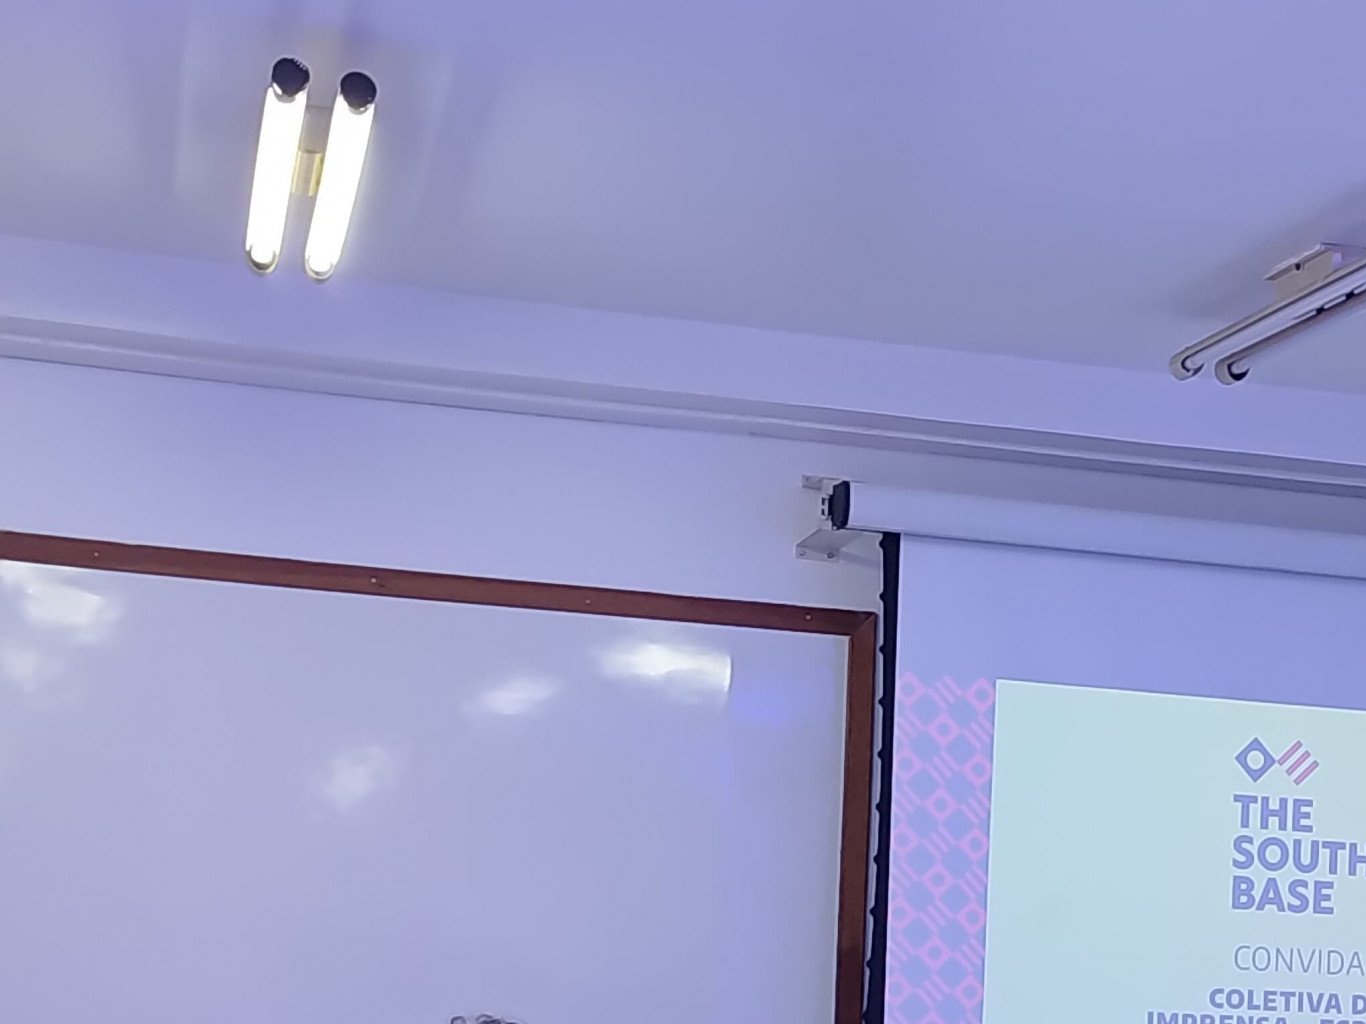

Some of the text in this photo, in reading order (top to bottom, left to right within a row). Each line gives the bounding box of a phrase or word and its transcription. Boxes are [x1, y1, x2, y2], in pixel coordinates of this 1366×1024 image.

[1232, 794, 1314, 833] THE
[1231, 875, 1335, 915] BASE
[1234, 945, 1365, 976] CONVIDA
[1208, 987, 1342, 1014] COLETIVA
